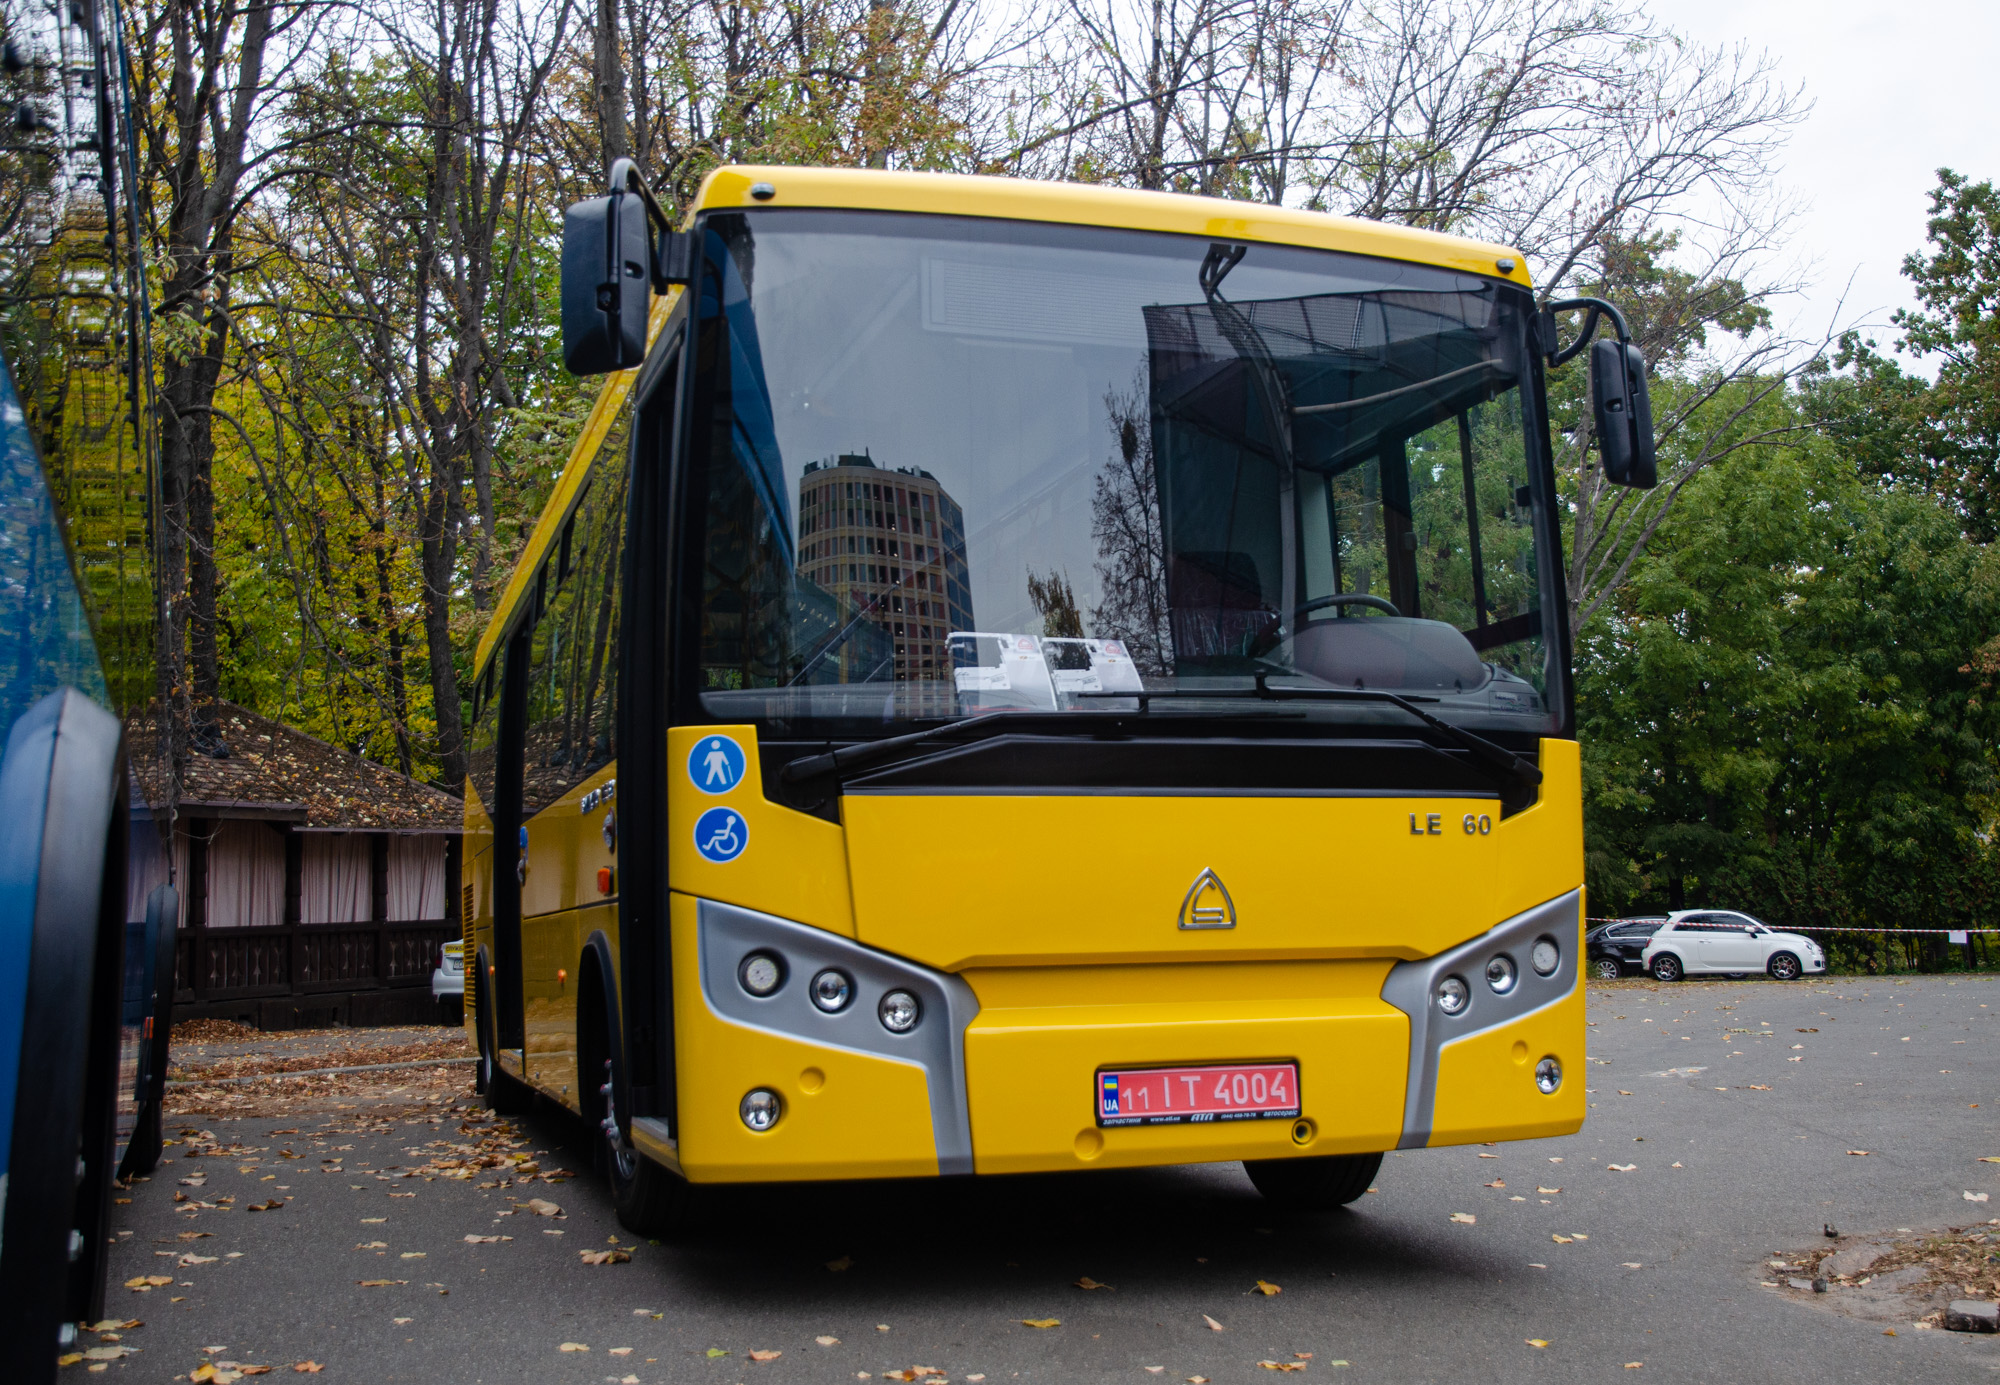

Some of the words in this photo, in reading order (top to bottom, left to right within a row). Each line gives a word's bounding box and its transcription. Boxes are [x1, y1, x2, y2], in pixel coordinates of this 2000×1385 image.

[1409, 813, 1441, 835] LE
[1463, 813, 1491, 835] 60
[1122, 1087, 1149, 1111] 11
[1214, 1071, 1287, 1106] 4004
[1104, 1099, 1119, 1111] UA
